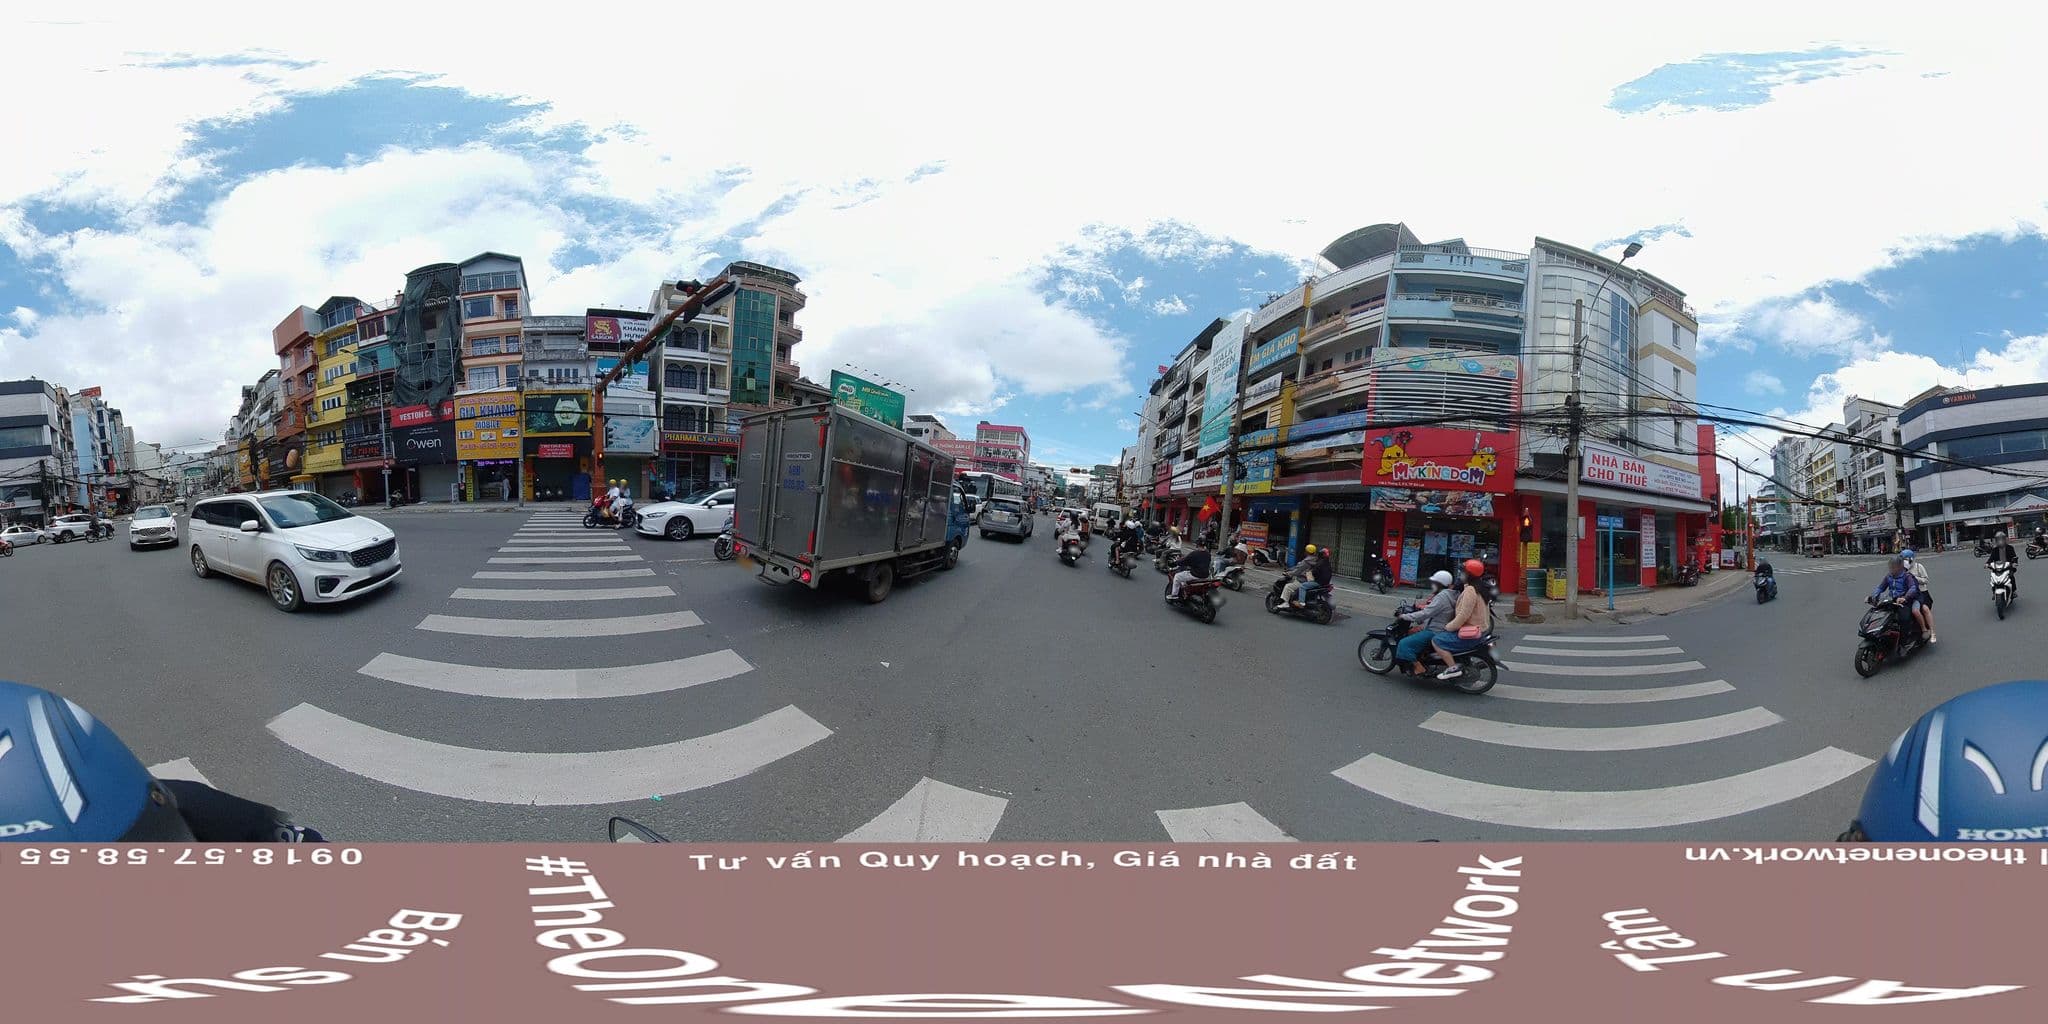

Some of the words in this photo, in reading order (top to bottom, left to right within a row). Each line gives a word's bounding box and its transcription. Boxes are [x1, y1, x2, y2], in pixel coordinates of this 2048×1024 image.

[1211, 354, 1236, 375] GREEN
[1950, 393, 1975, 404] YAMAHA
[399, 410, 424, 421] VESTON
[459, 406, 476, 418] GIA
[479, 404, 517, 418] KHANG
[475, 420, 501, 430] MOBILE
[406, 438, 442, 449] Owen
[664, 434, 707, 443] PHARMACY
[1592, 453, 1618, 468] NHÀ
[1623, 459, 1645, 474] BÁN
[1393, 462, 1486, 485] MYKINGDOM
[1588, 466, 1615, 481] CHO
[1619, 471, 1648, 487] THUÊ
